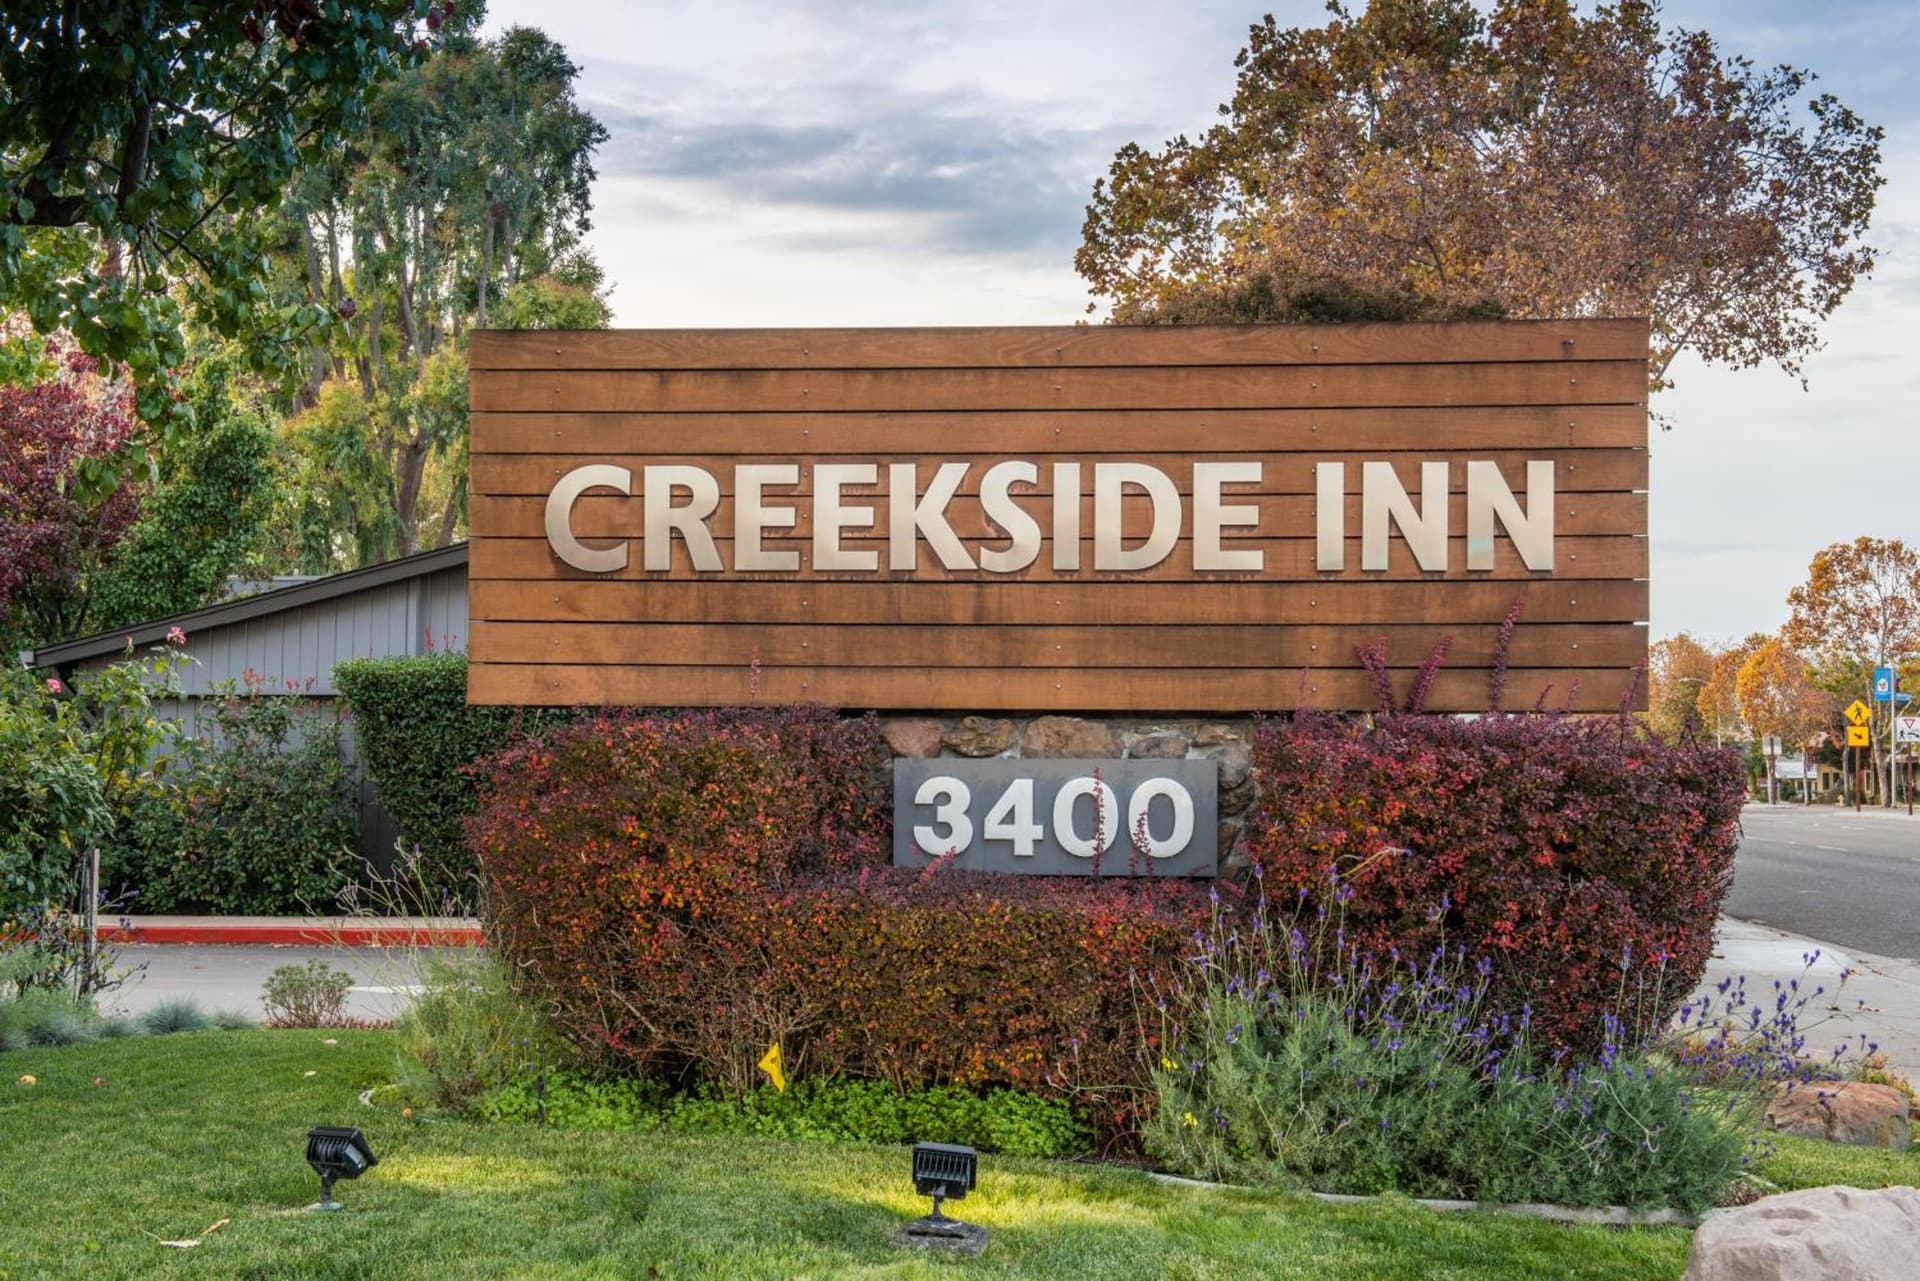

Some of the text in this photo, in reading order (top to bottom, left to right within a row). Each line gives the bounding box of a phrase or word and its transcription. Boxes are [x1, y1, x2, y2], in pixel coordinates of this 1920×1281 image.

[545, 460, 1554, 572] CREEKSIDE INN
[913, 776, 1194, 858] 3400
